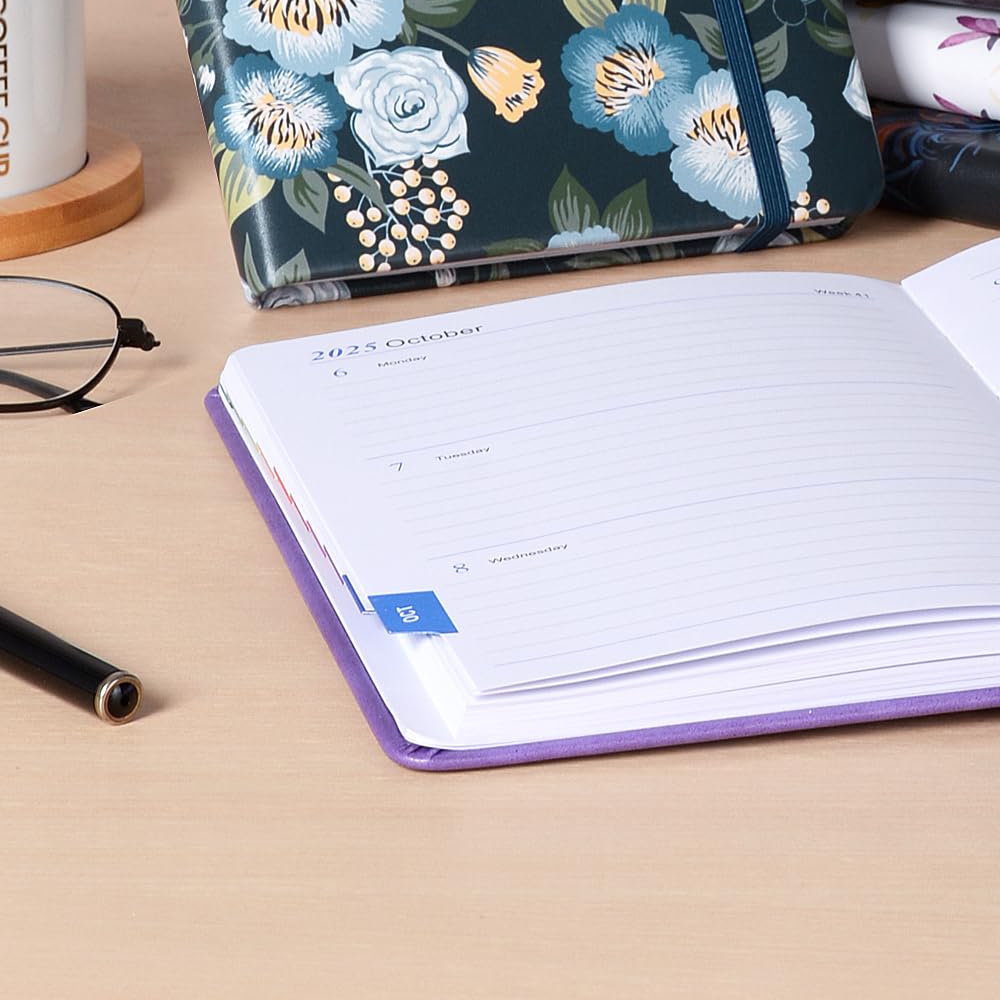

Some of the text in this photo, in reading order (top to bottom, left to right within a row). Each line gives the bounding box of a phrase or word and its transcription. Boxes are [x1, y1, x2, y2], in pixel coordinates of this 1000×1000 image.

[311, 325, 483, 362] 2025 October
[332, 355, 428, 378] 6 Monday
[389, 447, 491, 472] 7 Tuesday
[452, 543, 568, 574] 8 Wednesday
[396, 605, 420, 624] OCT
